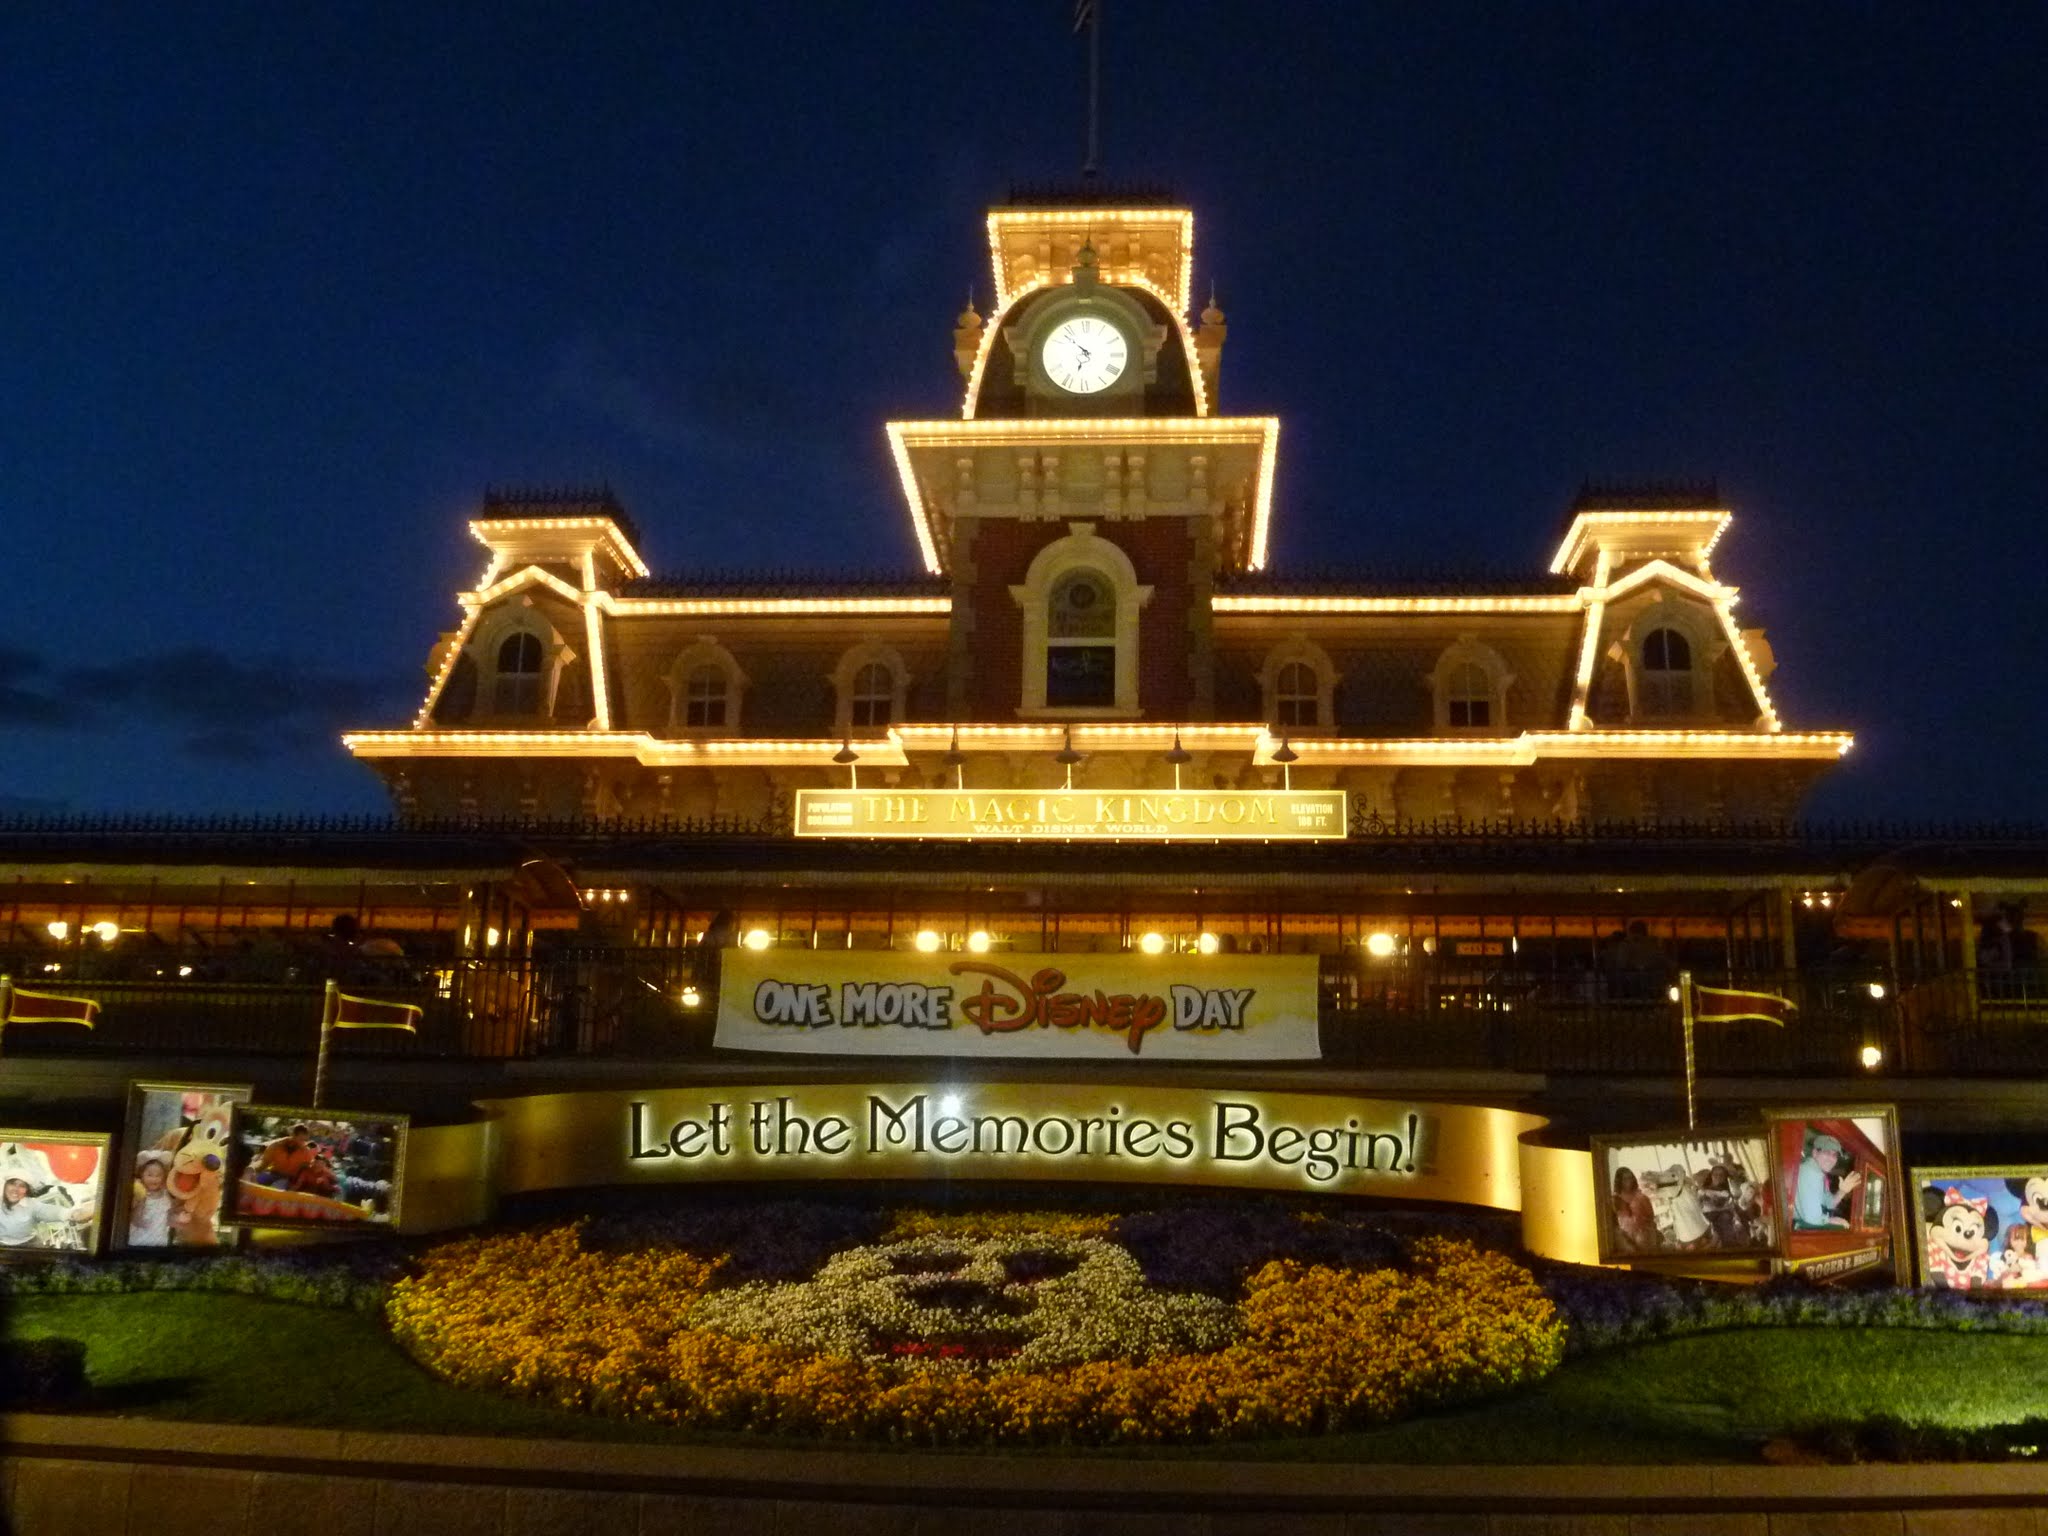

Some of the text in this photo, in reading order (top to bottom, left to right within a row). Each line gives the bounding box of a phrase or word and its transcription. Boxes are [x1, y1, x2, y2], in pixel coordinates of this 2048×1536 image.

[861, 797, 929, 823] THE
[948, 796, 1076, 824] MAGIC
[1095, 797, 1278, 824] KINGDOM
[1290, 803, 1333, 815] ELEVATION
[973, 824, 1168, 834] WALT DISNEY WORLD
[754, 979, 832, 1027] ONE
[840, 981, 954, 1030] MORE
[1170, 985, 1257, 1033] DAY
[630, 1095, 1418, 1181] Let the Memories Begin!
